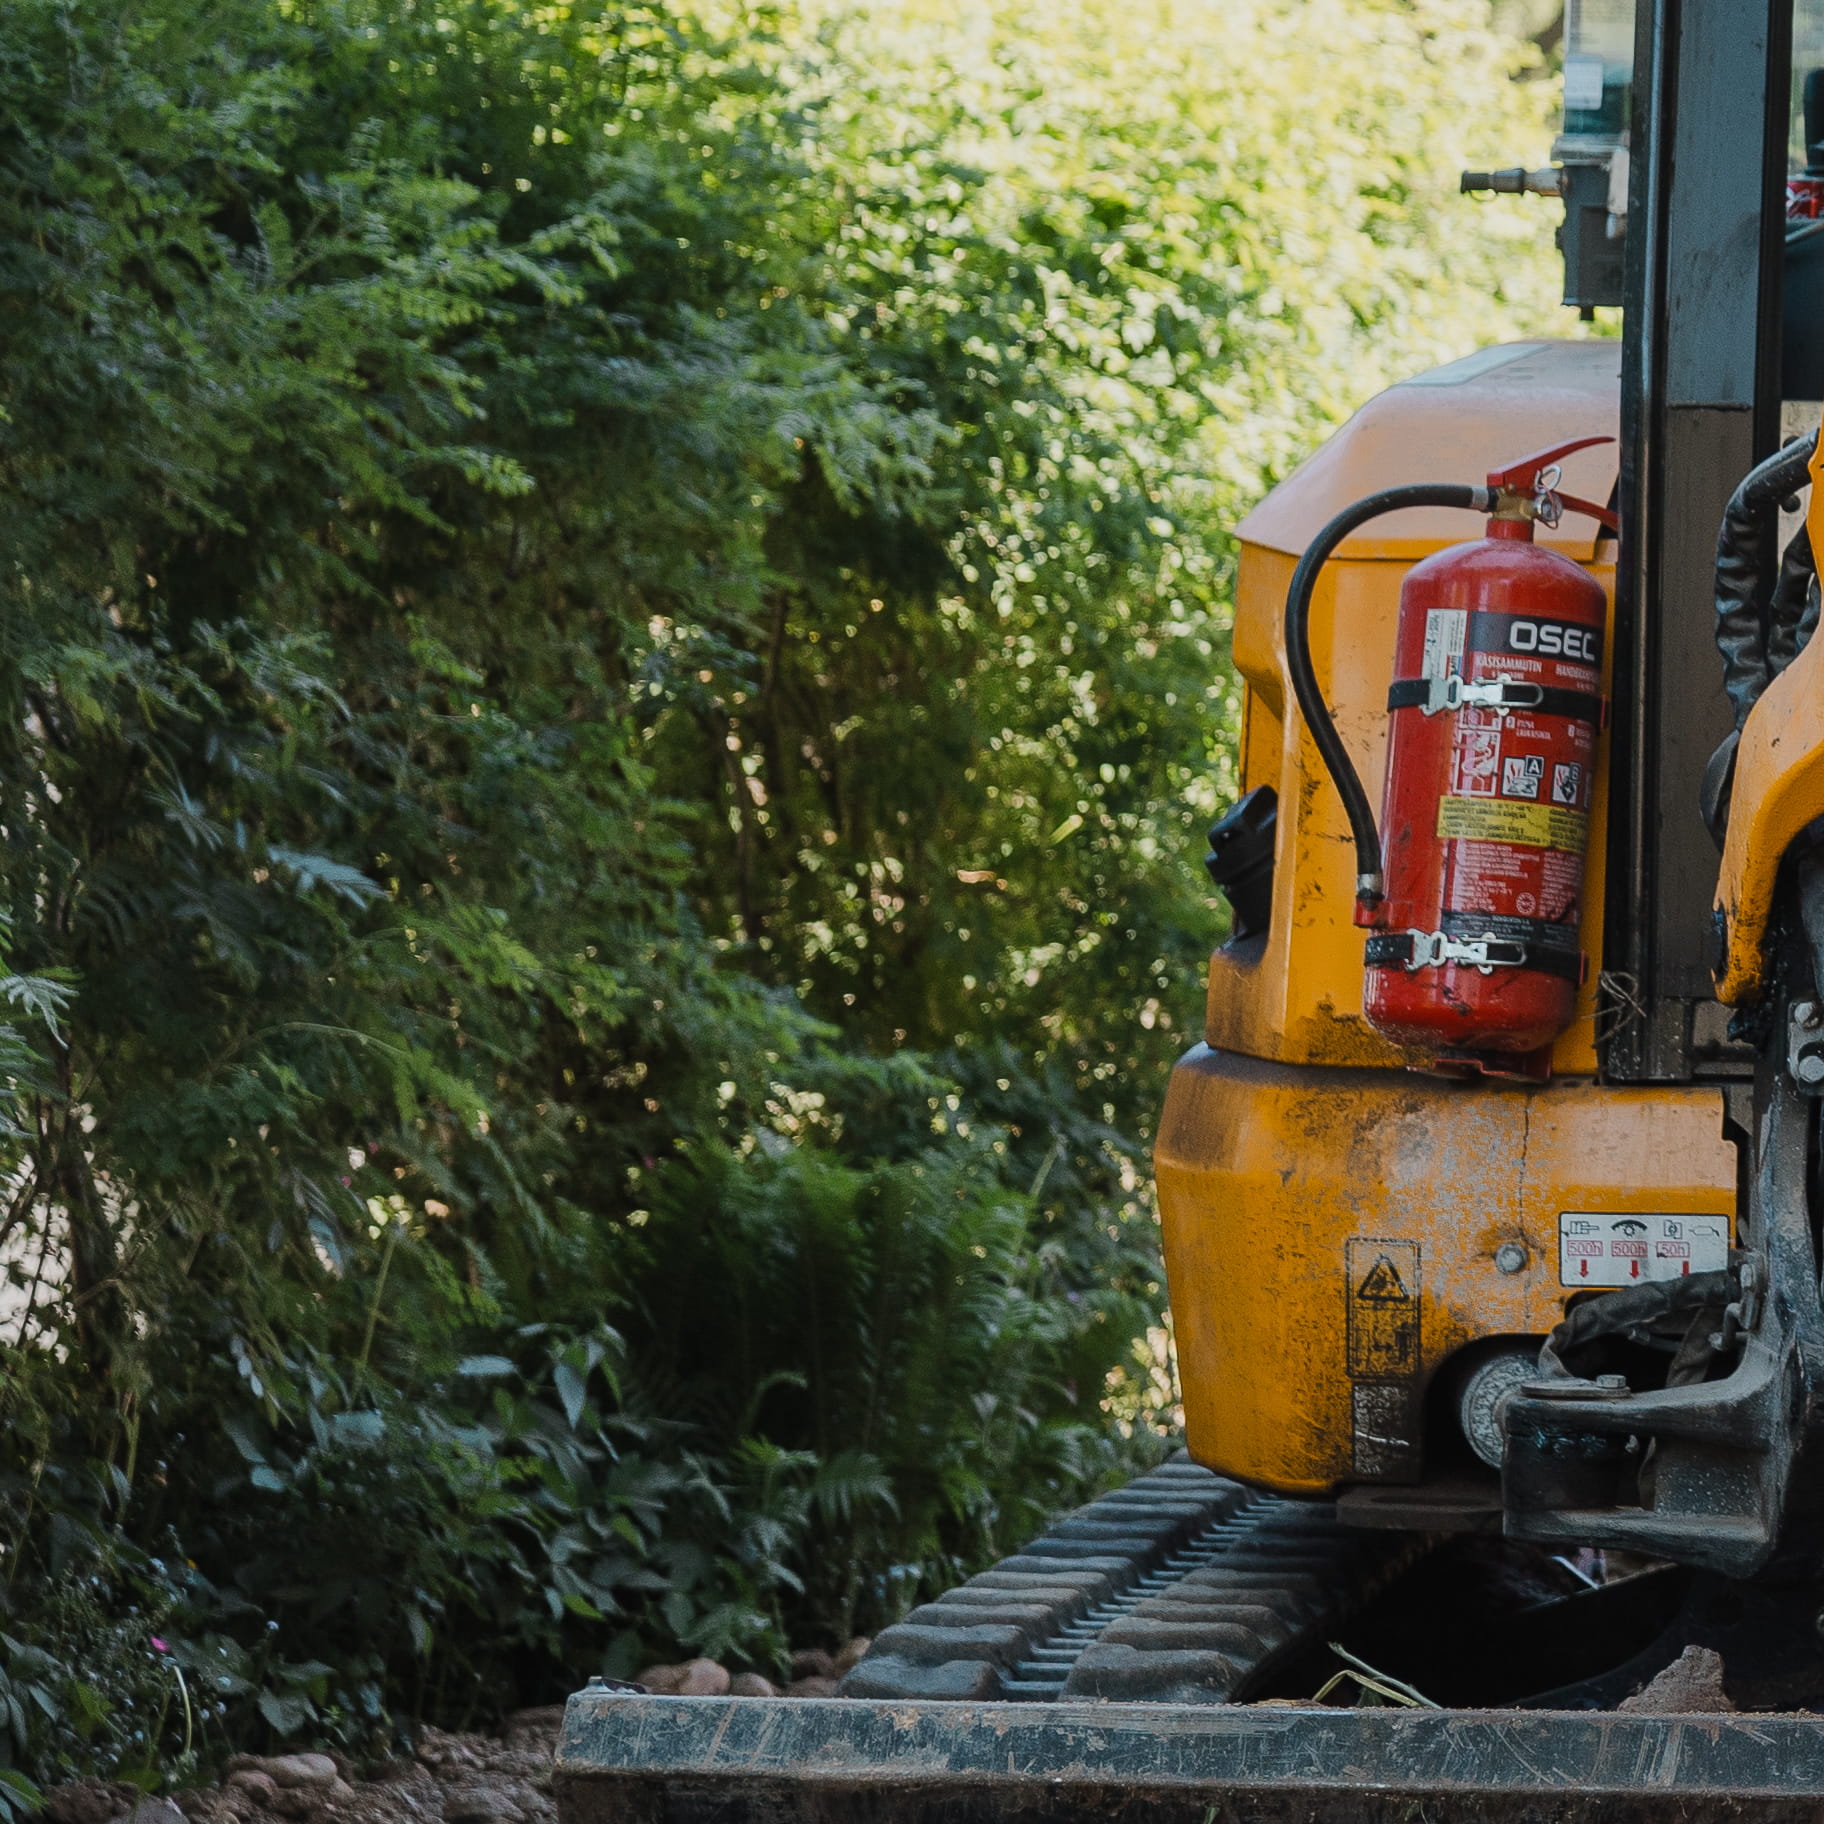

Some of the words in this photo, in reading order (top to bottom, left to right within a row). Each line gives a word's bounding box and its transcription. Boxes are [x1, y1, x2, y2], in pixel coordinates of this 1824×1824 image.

[1528, 759, 1541, 775] A
[1568, 1242, 1603, 1256] 500h
[1613, 1242, 1648, 1257] 500h
[1662, 1243, 1685, 1257] 50h
